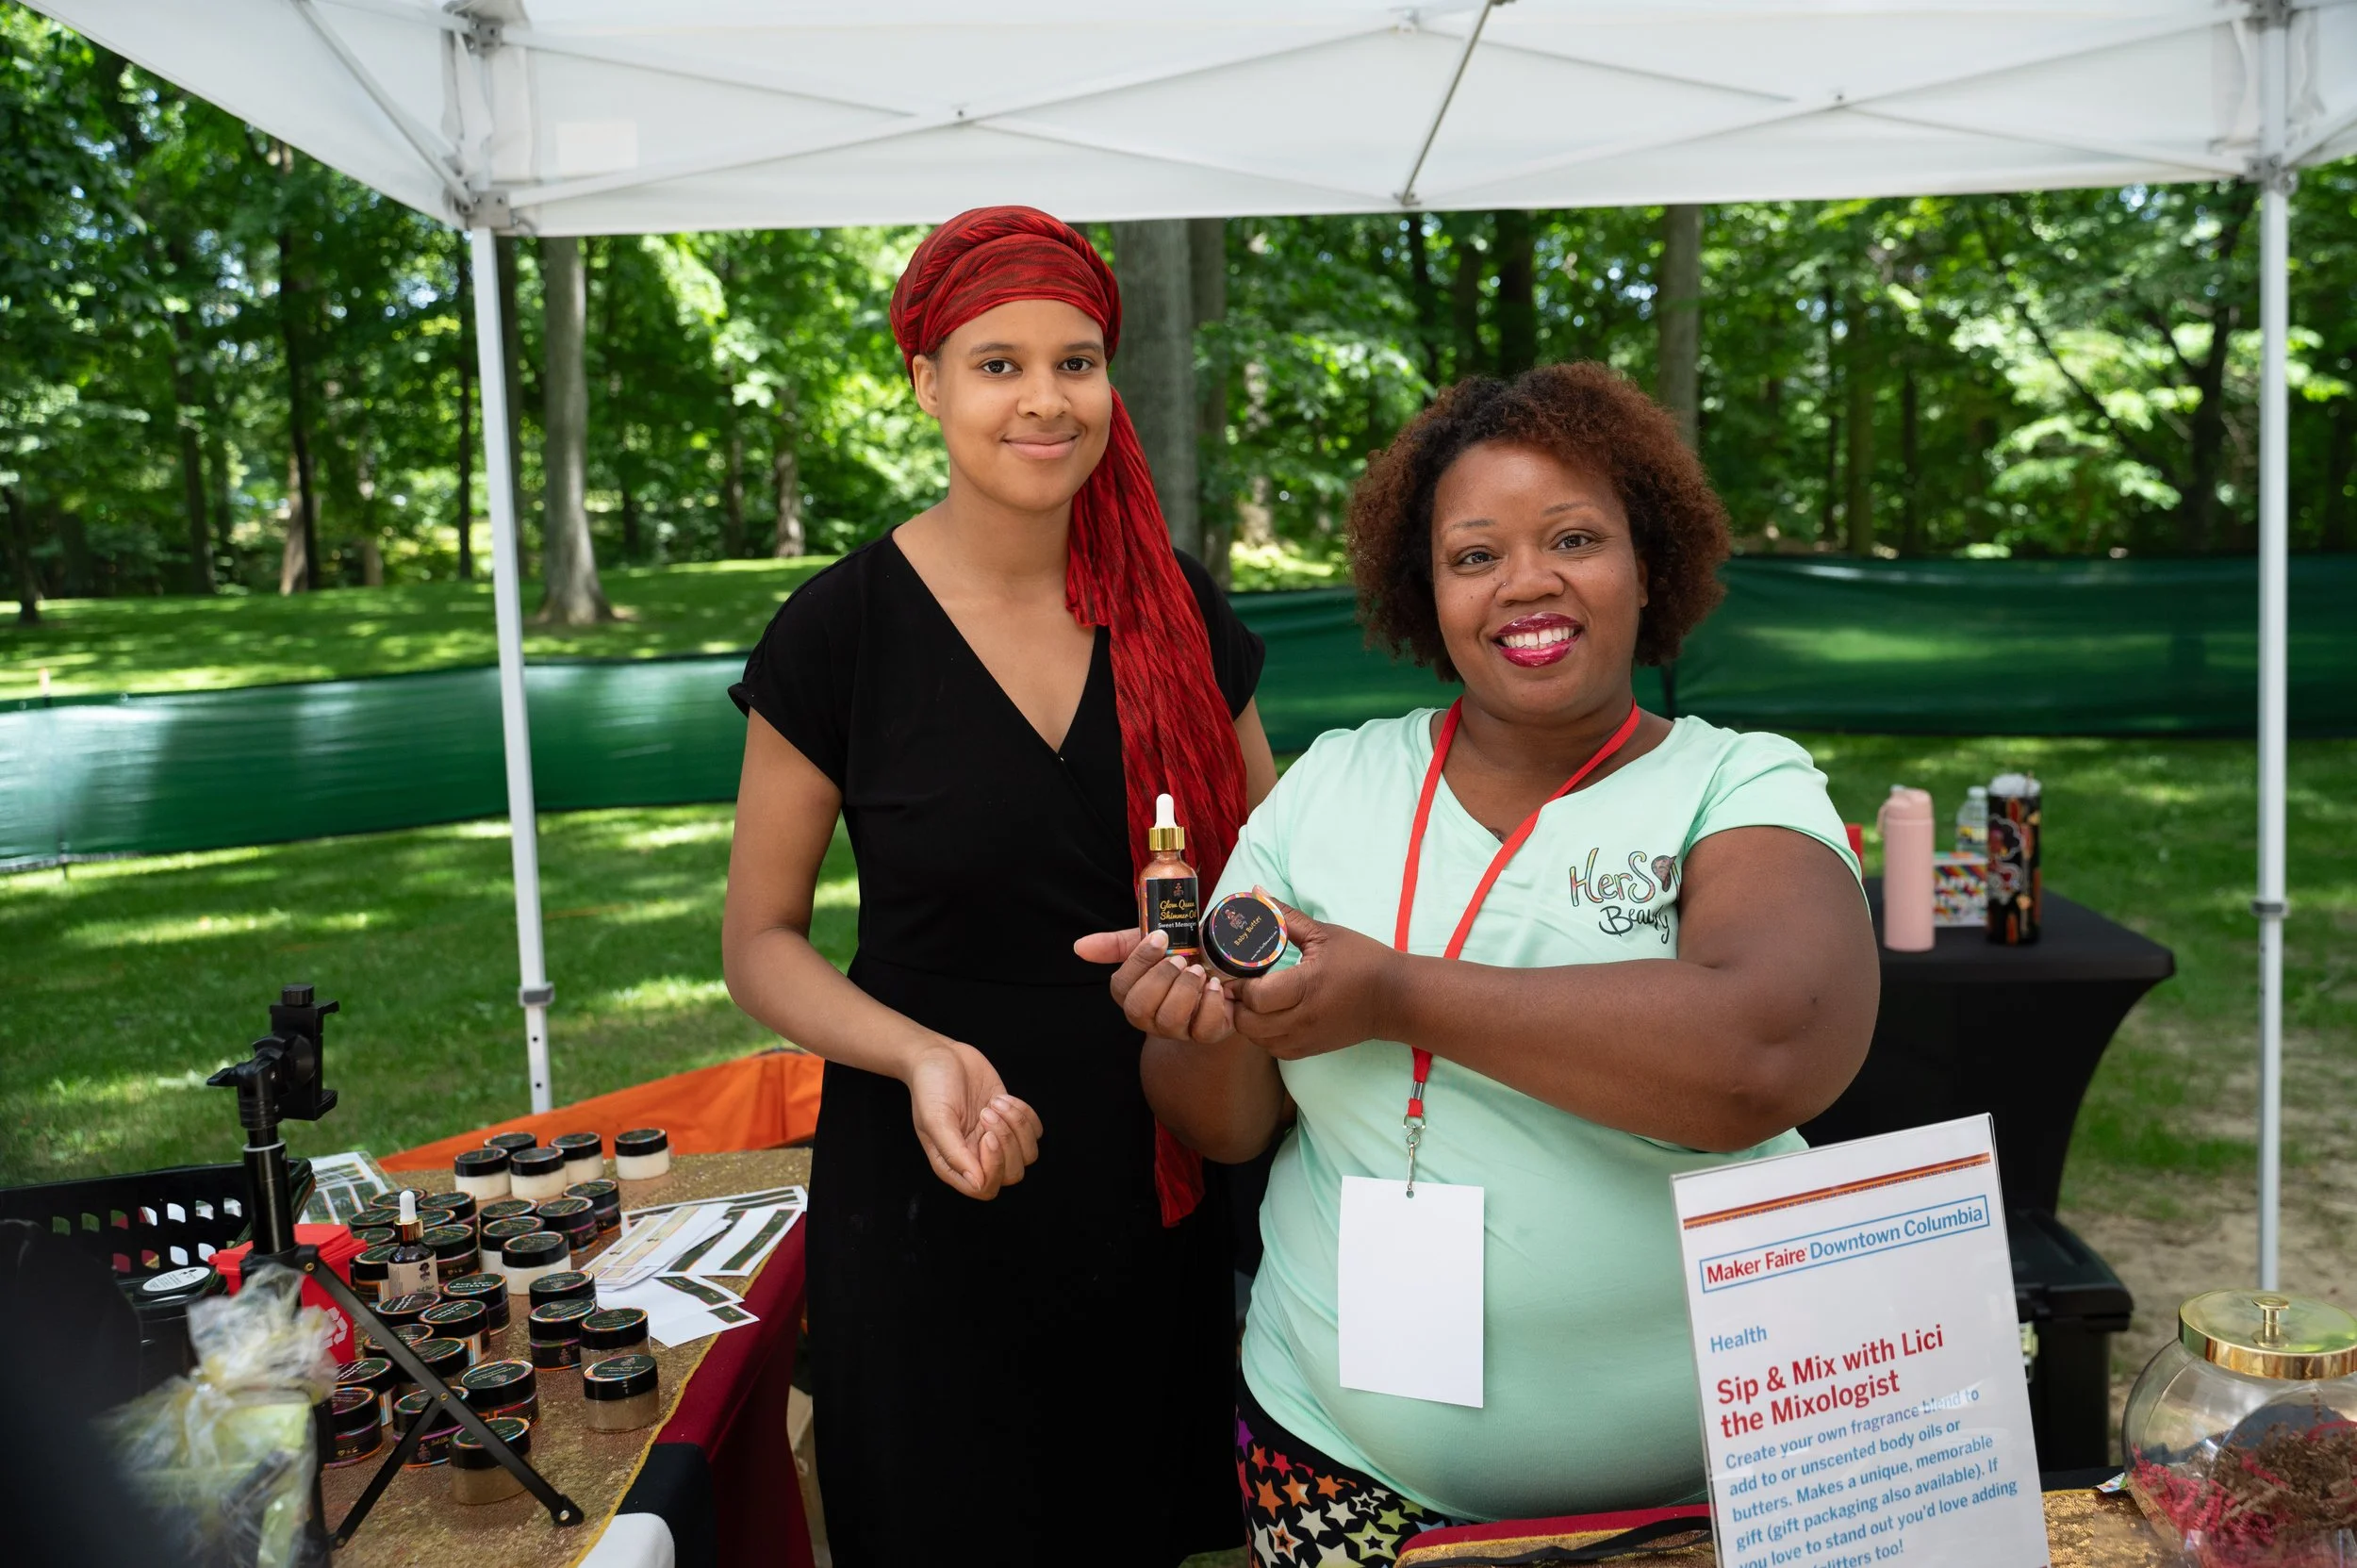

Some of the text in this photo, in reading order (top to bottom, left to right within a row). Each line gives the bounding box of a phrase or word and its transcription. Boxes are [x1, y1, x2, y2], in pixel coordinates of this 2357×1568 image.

[1233, 932, 1249, 947] Baby
[1245, 916, 1261, 933] Butter
[1706, 1206, 1983, 1284] Maker Faire Downtown Columbia
[1710, 1326, 1768, 1354] Health
[1717, 1324, 1944, 1406] Sip & Mix with Lici
[1721, 1369, 1901, 1439] the Mixologist
[1725, 1389, 1980, 1469] Create your own fragrance blend to
[1729, 1419, 1961, 1497] add to or unscented body oils or
[1733, 1434, 1994, 1523] butters. Makes a unique, memorable
[1736, 1457, 1999, 1552] gift (gift packaging also available). If
[1739, 1479, 2019, 1568] ou love to stand out you'd love adding
[1874, 1538, 1904, 1561] too!
